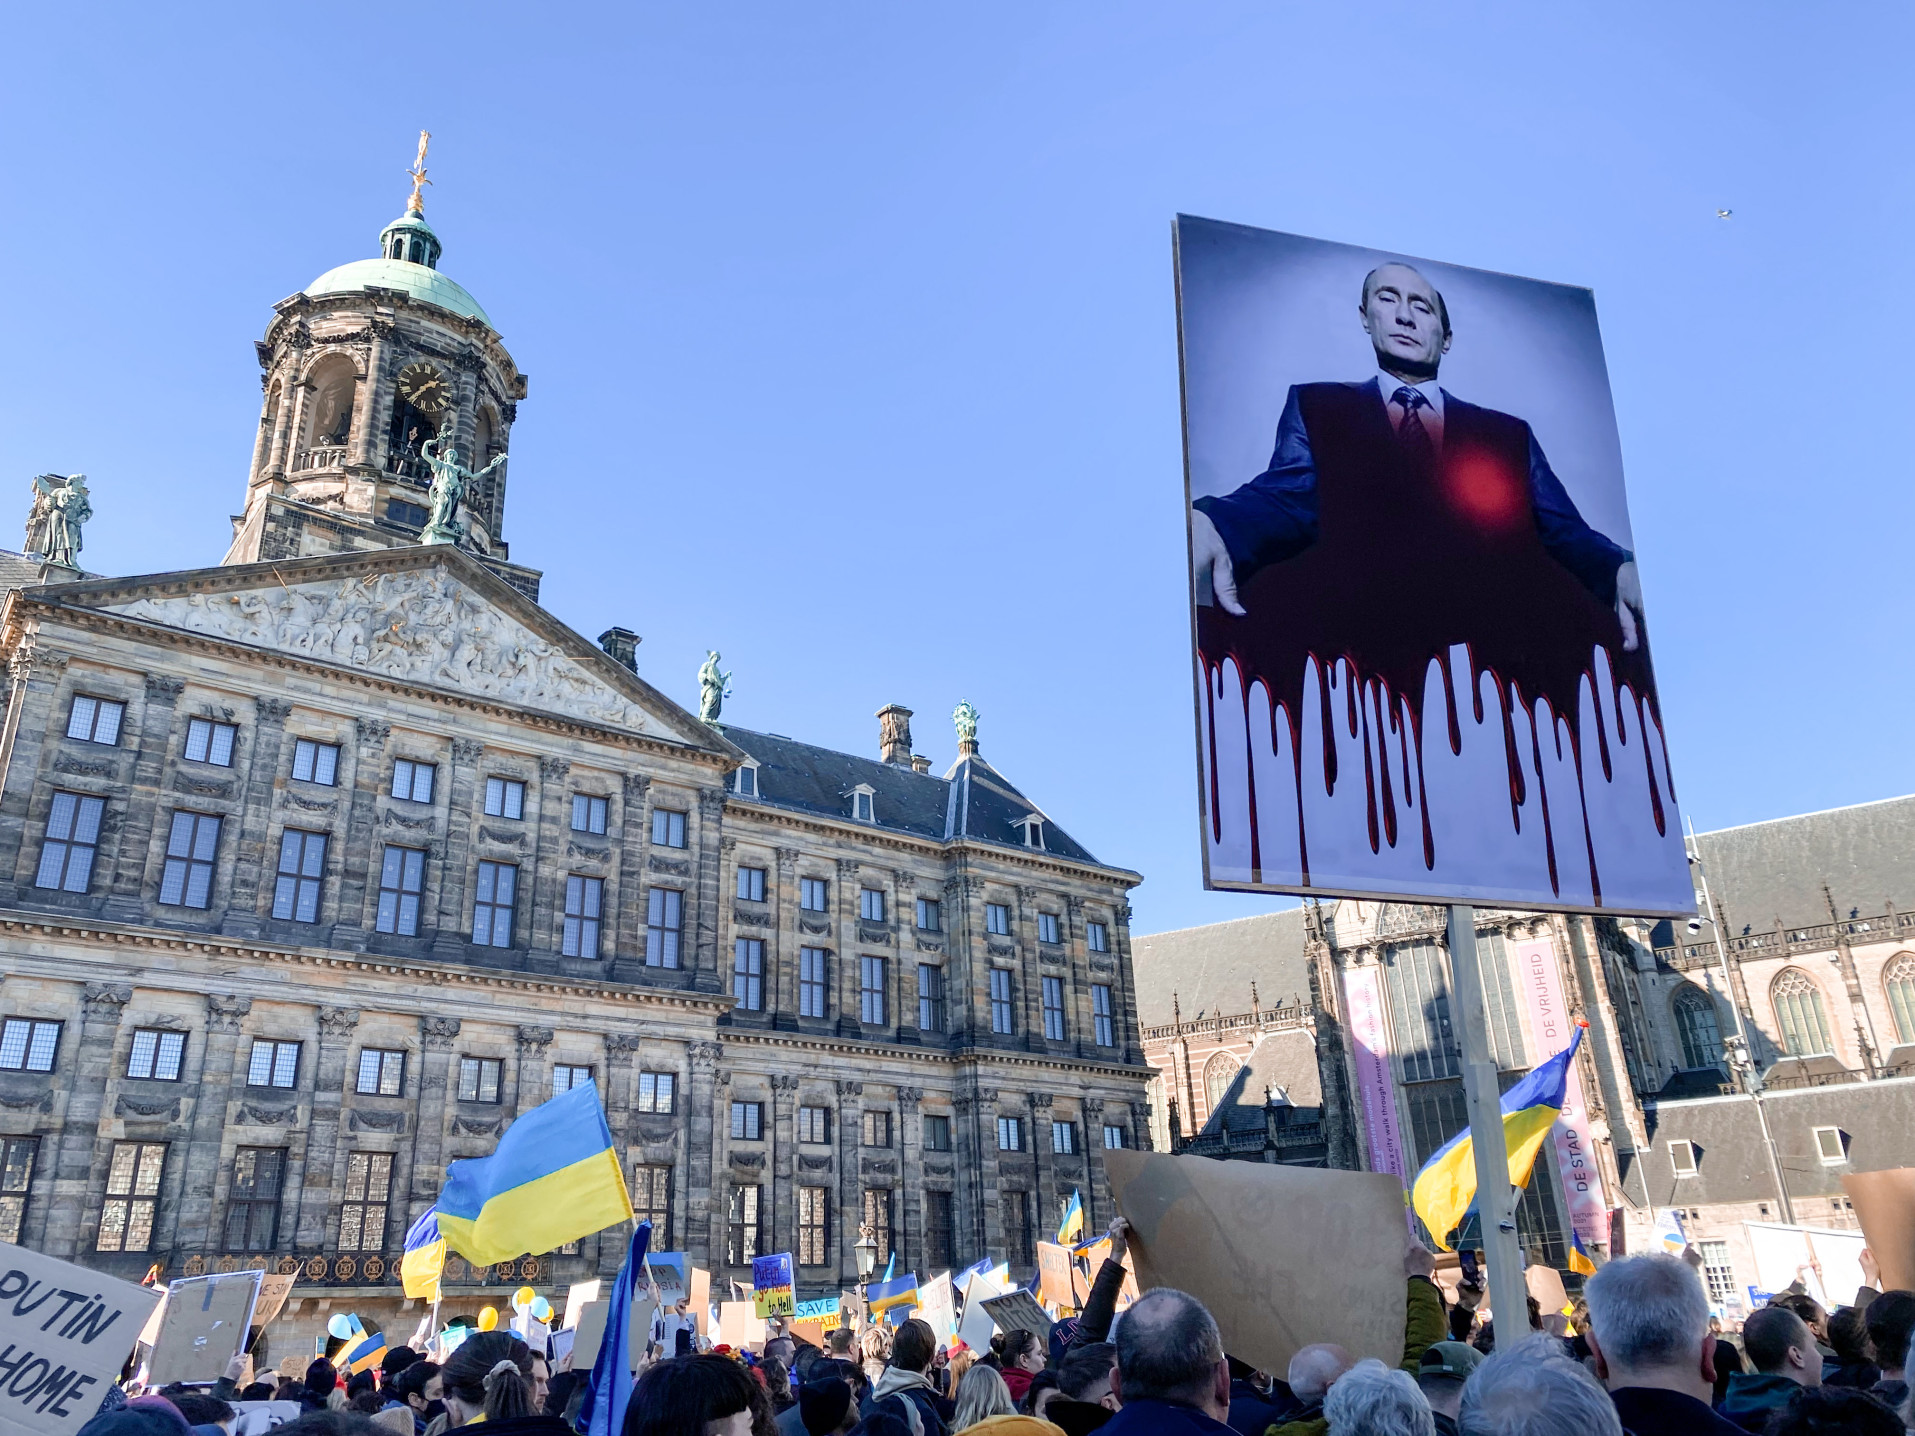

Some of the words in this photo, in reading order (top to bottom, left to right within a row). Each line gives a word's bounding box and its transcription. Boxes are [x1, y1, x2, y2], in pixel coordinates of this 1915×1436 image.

[1530, 953, 1552, 1017] VRIJHEID
[1543, 1019, 1557, 1038] DE
[1378, 1086, 1389, 1116] through
[1382, 1117, 1392, 1136] walk
[1387, 1137, 1396, 1153] city
[1565, 1129, 1584, 1168] STAD
[1573, 1171, 1588, 1192] DE
[758, 1284, 769, 1302] go
[771, 1281, 792, 1294] home
[777, 1295, 792, 1313] Hell
[797, 1299, 835, 1318] SAVE
[0, 1343, 98, 1418] HOME
